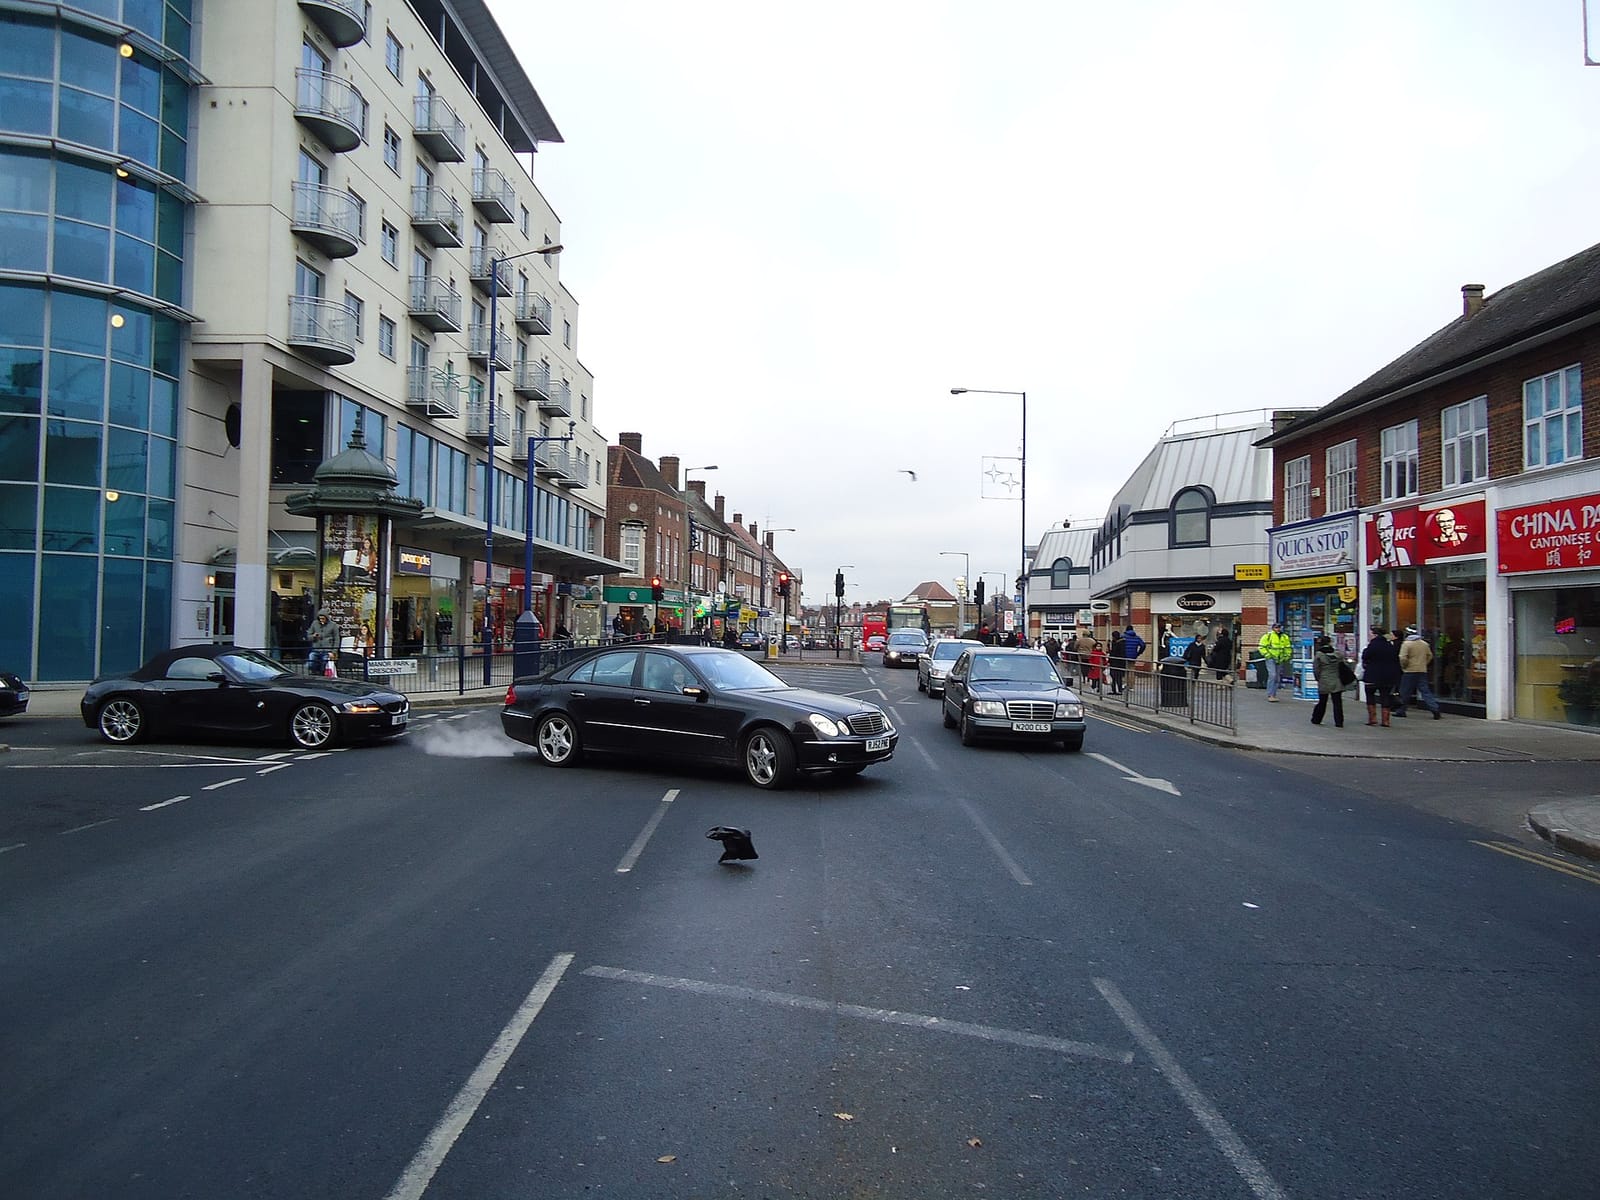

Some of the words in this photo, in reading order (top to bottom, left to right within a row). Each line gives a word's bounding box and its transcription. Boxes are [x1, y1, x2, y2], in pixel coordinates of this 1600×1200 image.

[1510, 508, 1576, 538] CHINA
[1394, 526, 1417, 541] KFC
[1529, 532, 1591, 549] CANTONESE
[1276, 536, 1315, 561] QUICK
[1317, 530, 1349, 552] STOP
[1015, 723, 1034, 732] N200
[1035, 723, 1049, 732] CLS
